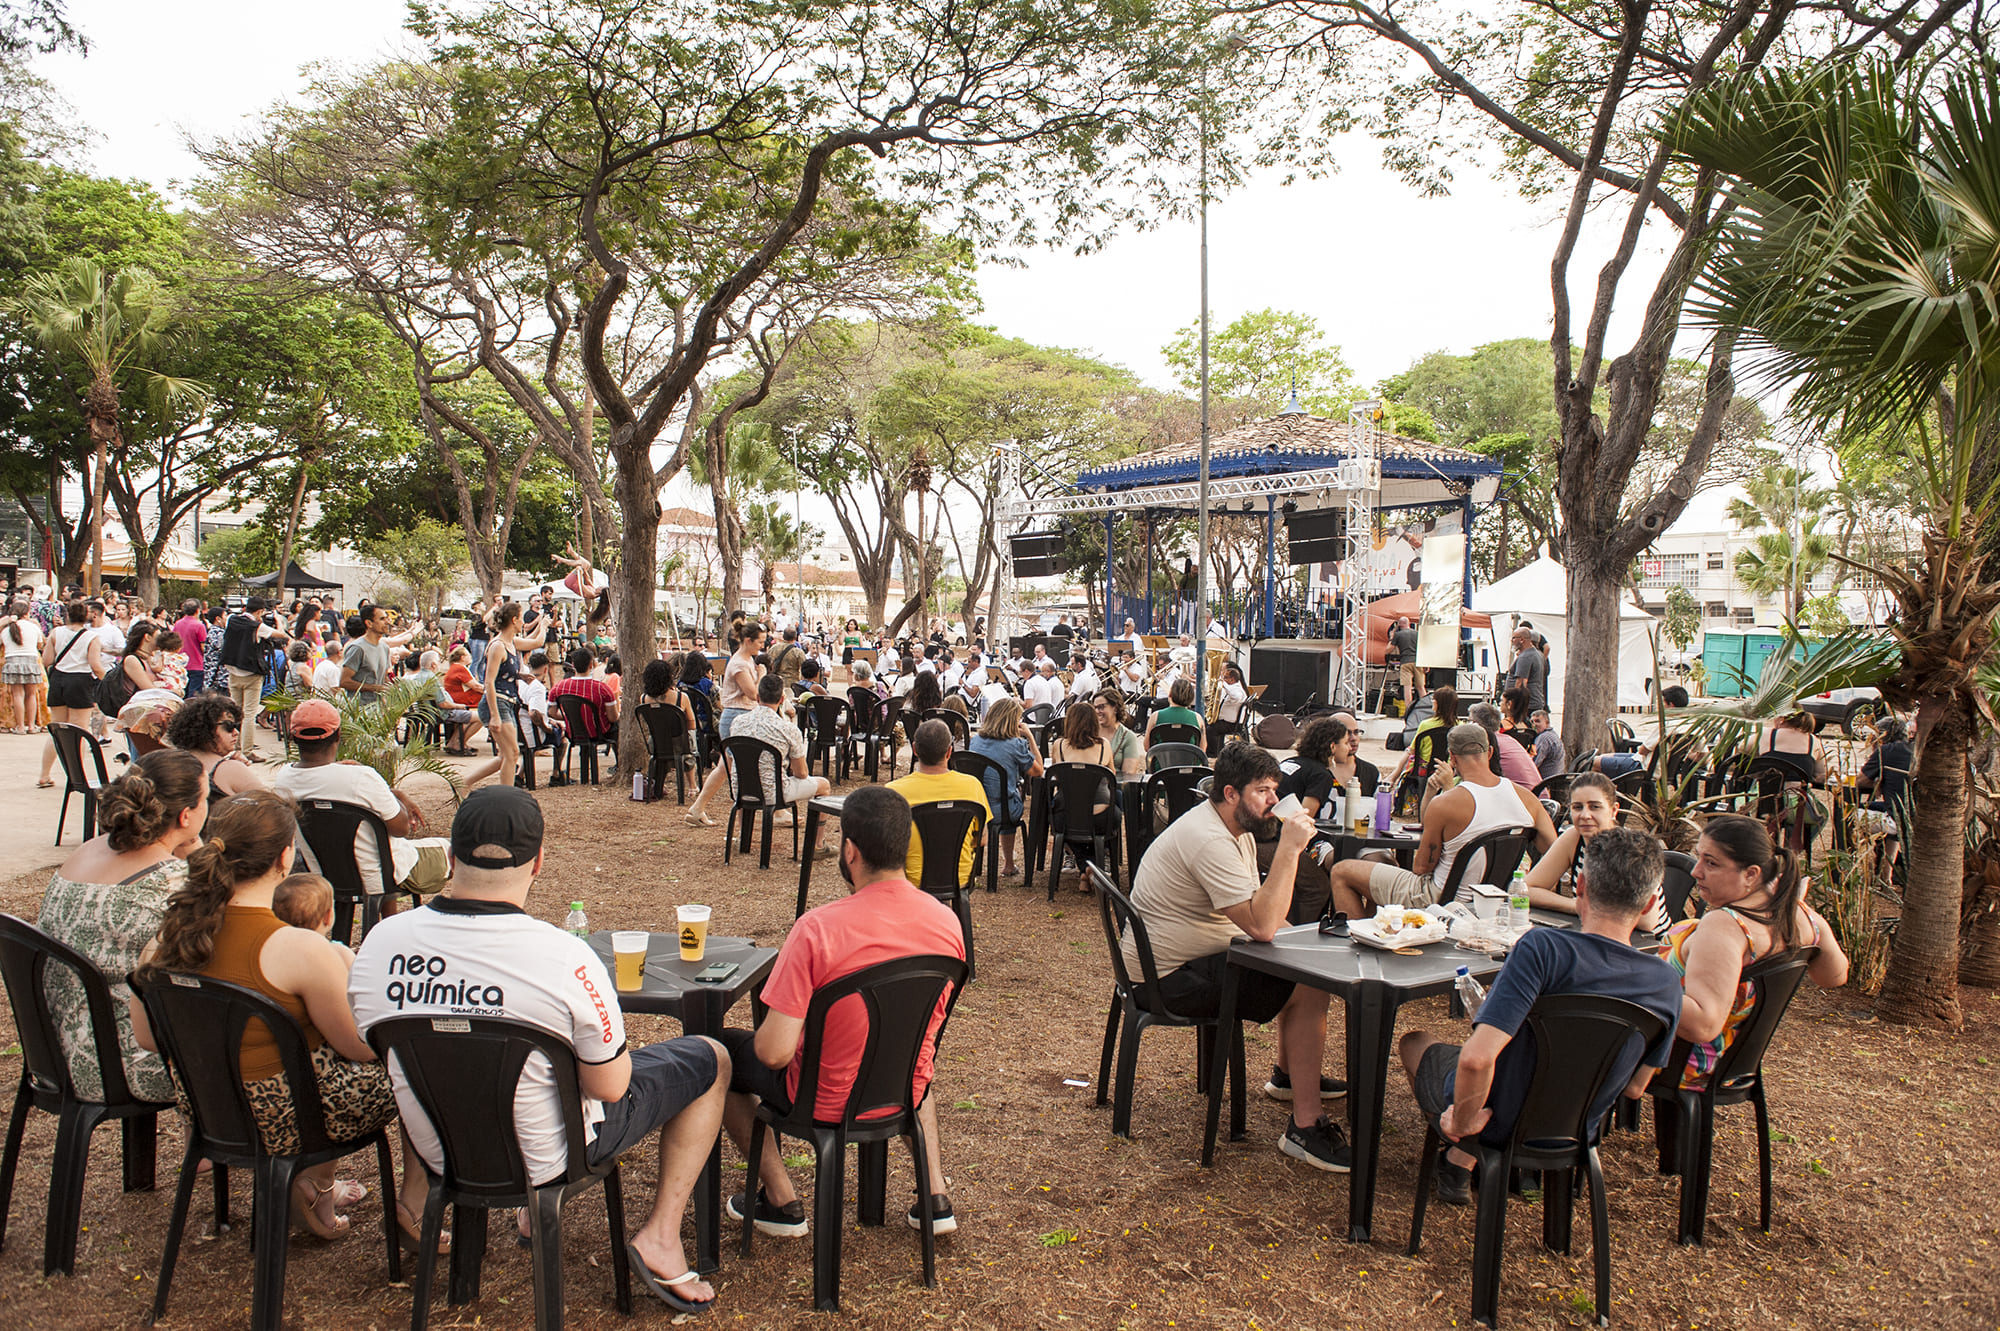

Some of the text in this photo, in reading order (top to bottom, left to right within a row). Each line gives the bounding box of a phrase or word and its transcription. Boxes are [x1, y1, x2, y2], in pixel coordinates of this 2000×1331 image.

[389, 954, 446, 977] neo
[386, 976, 505, 1011] química
[574, 964, 614, 1044] bozzano
